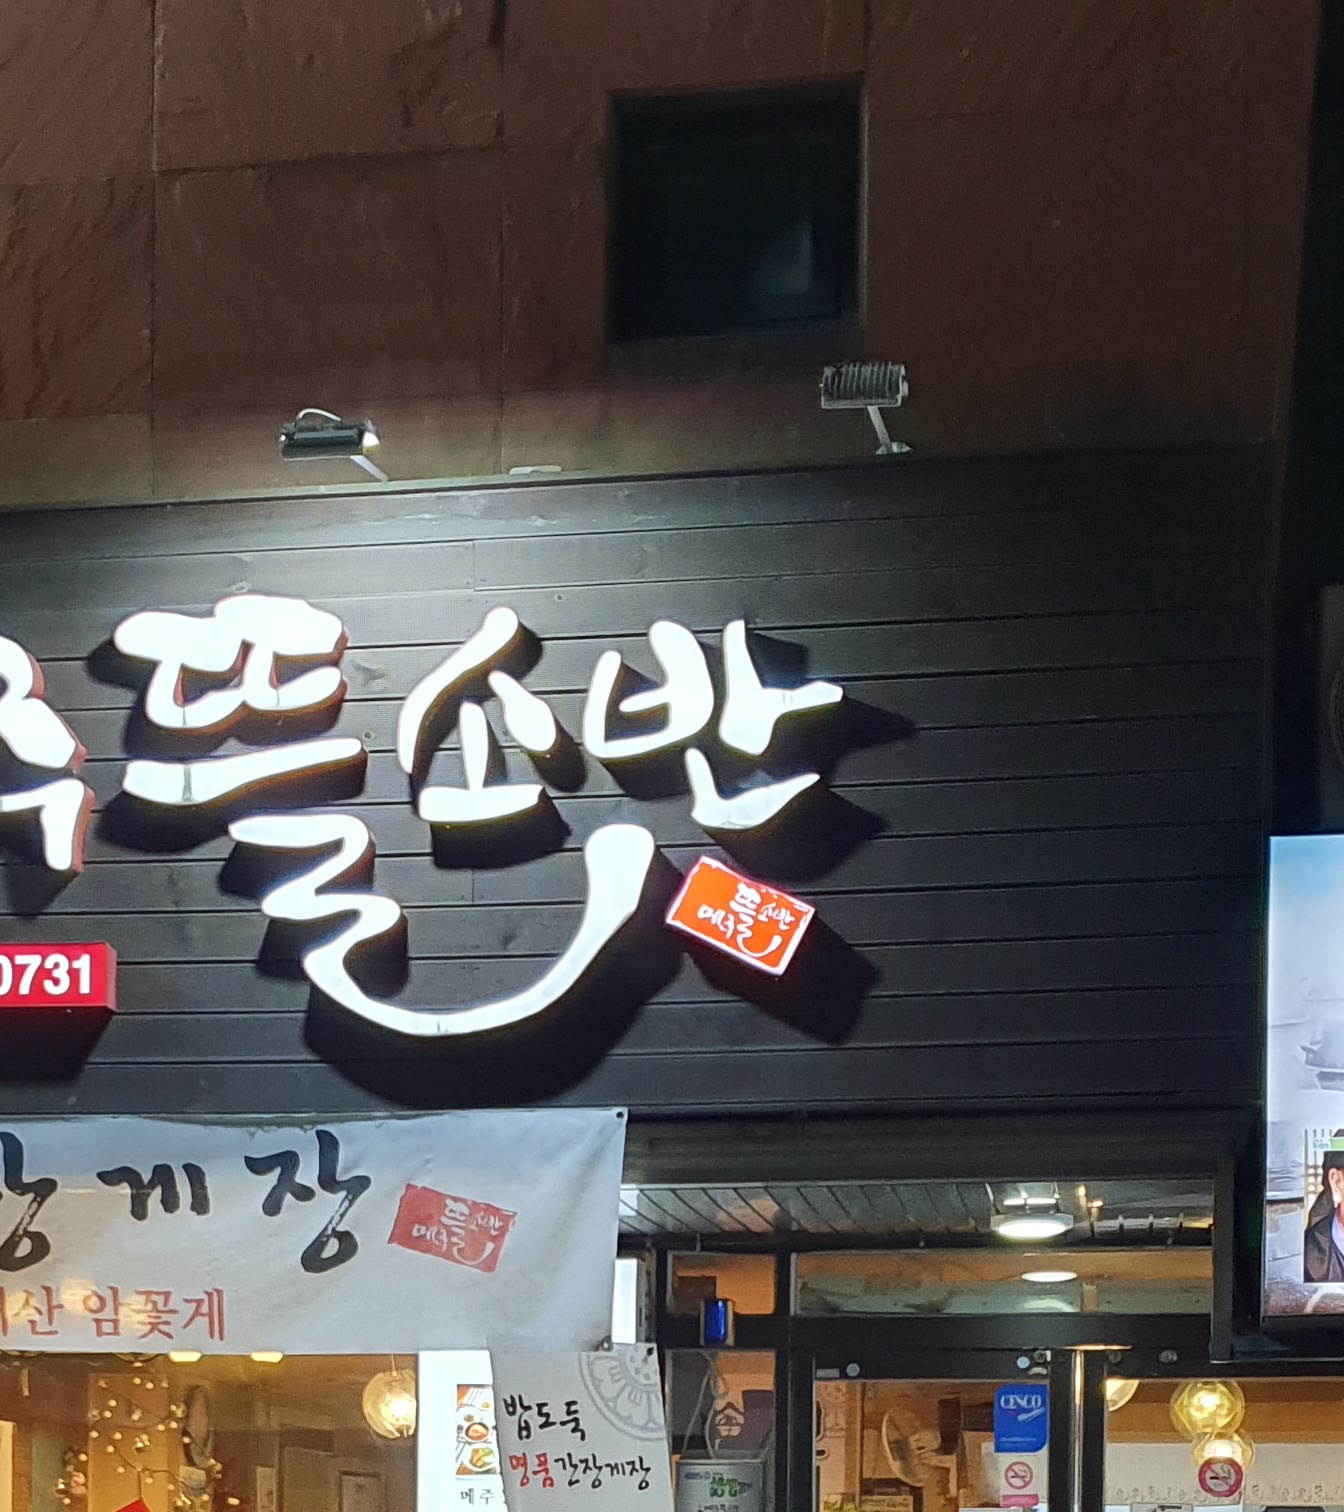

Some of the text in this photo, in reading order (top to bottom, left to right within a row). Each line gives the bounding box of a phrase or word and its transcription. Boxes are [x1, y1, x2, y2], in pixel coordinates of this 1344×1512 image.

[81, 1285, 228, 1341] 암꽃게
[503, 1394, 586, 1442] 밥도둑
[509, 1452, 652, 1491] 명품 간장게장
[460, 1489, 506, 1505] 메주
